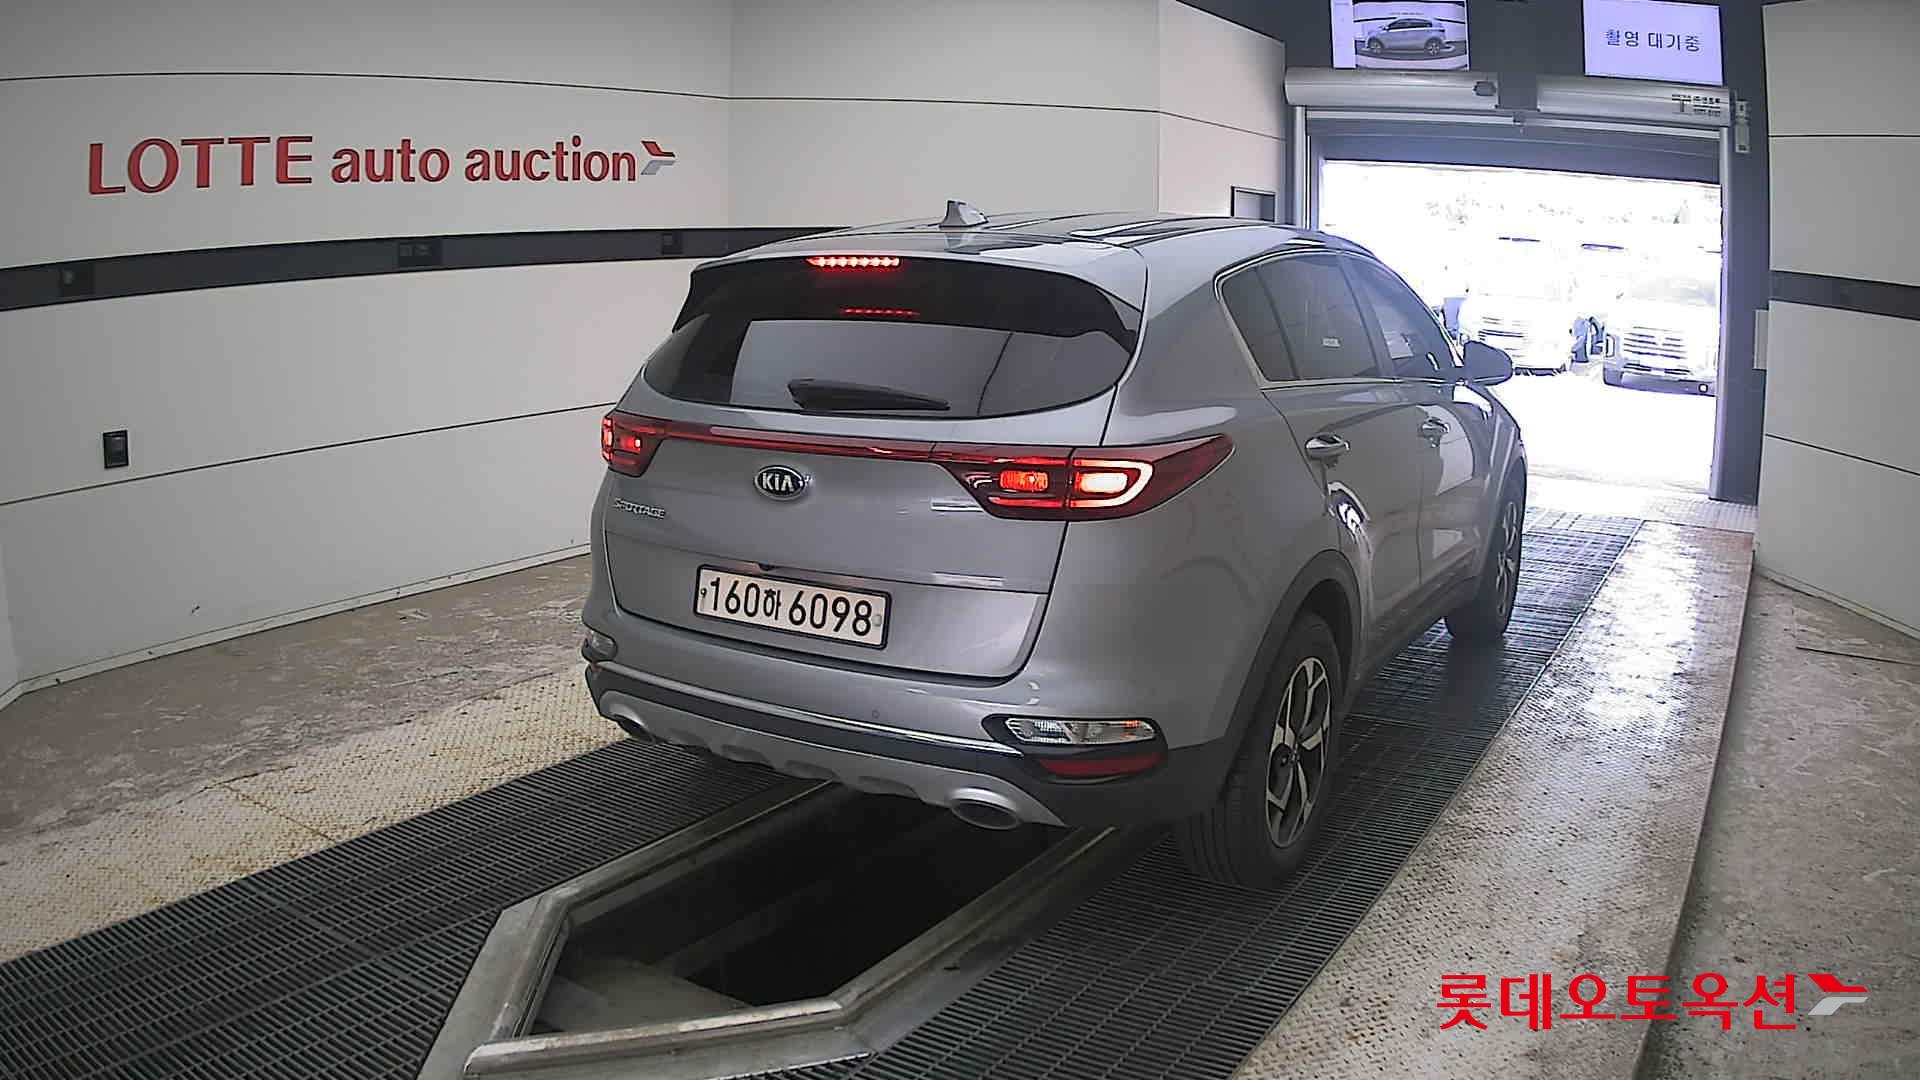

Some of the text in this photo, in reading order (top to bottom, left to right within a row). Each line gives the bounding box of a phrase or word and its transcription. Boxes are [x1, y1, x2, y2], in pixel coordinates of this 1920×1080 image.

[1647, 32, 1700, 52] 대기중
[89, 135, 636, 194] LOTTE auto auction
[762, 472, 794, 491] KIA
